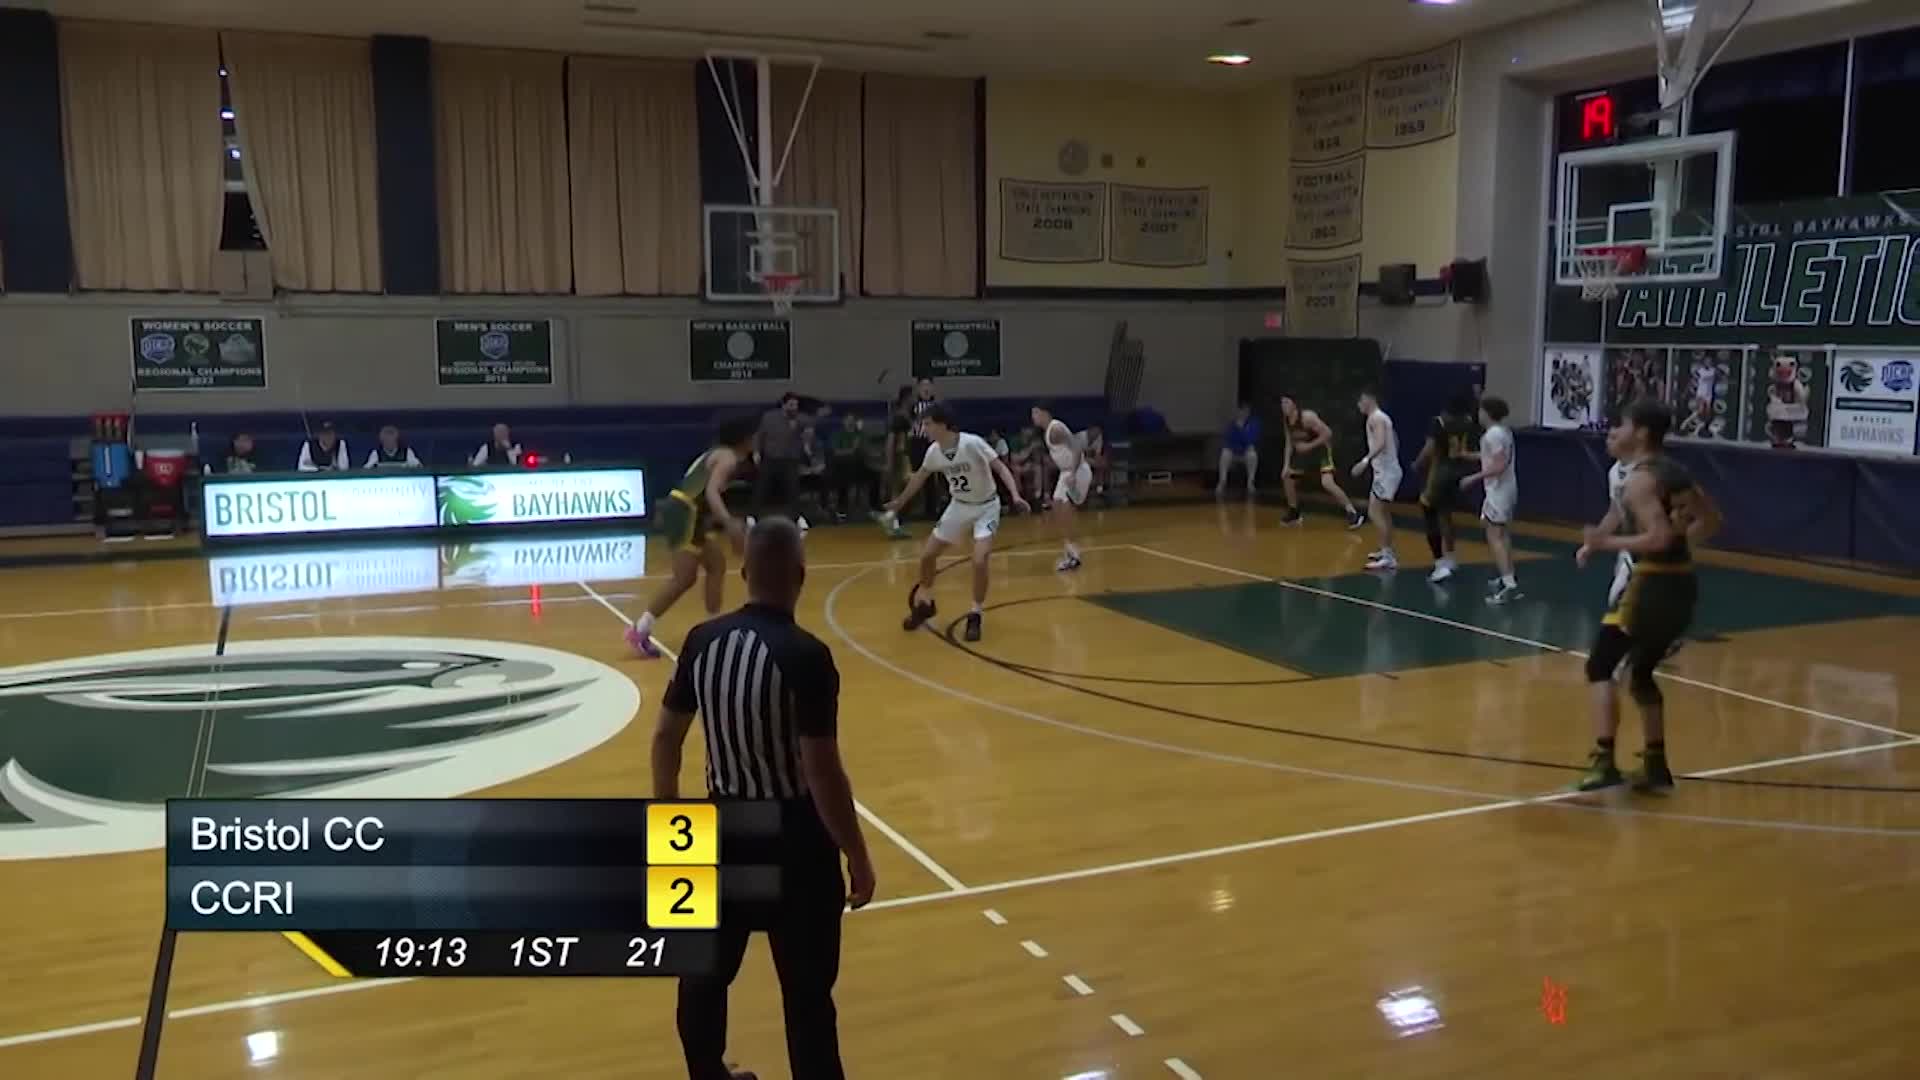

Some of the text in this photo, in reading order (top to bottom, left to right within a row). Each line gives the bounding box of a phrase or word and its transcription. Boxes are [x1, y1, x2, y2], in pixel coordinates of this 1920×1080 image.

[1584, 97, 1611, 139] 19
[142, 321, 253, 331] WOMEN'S SOCCER
[197, 368, 262, 377] CHAMPIONS
[214, 491, 337, 526] BRISTOL
[512, 488, 632, 518] BAYHAWKS
